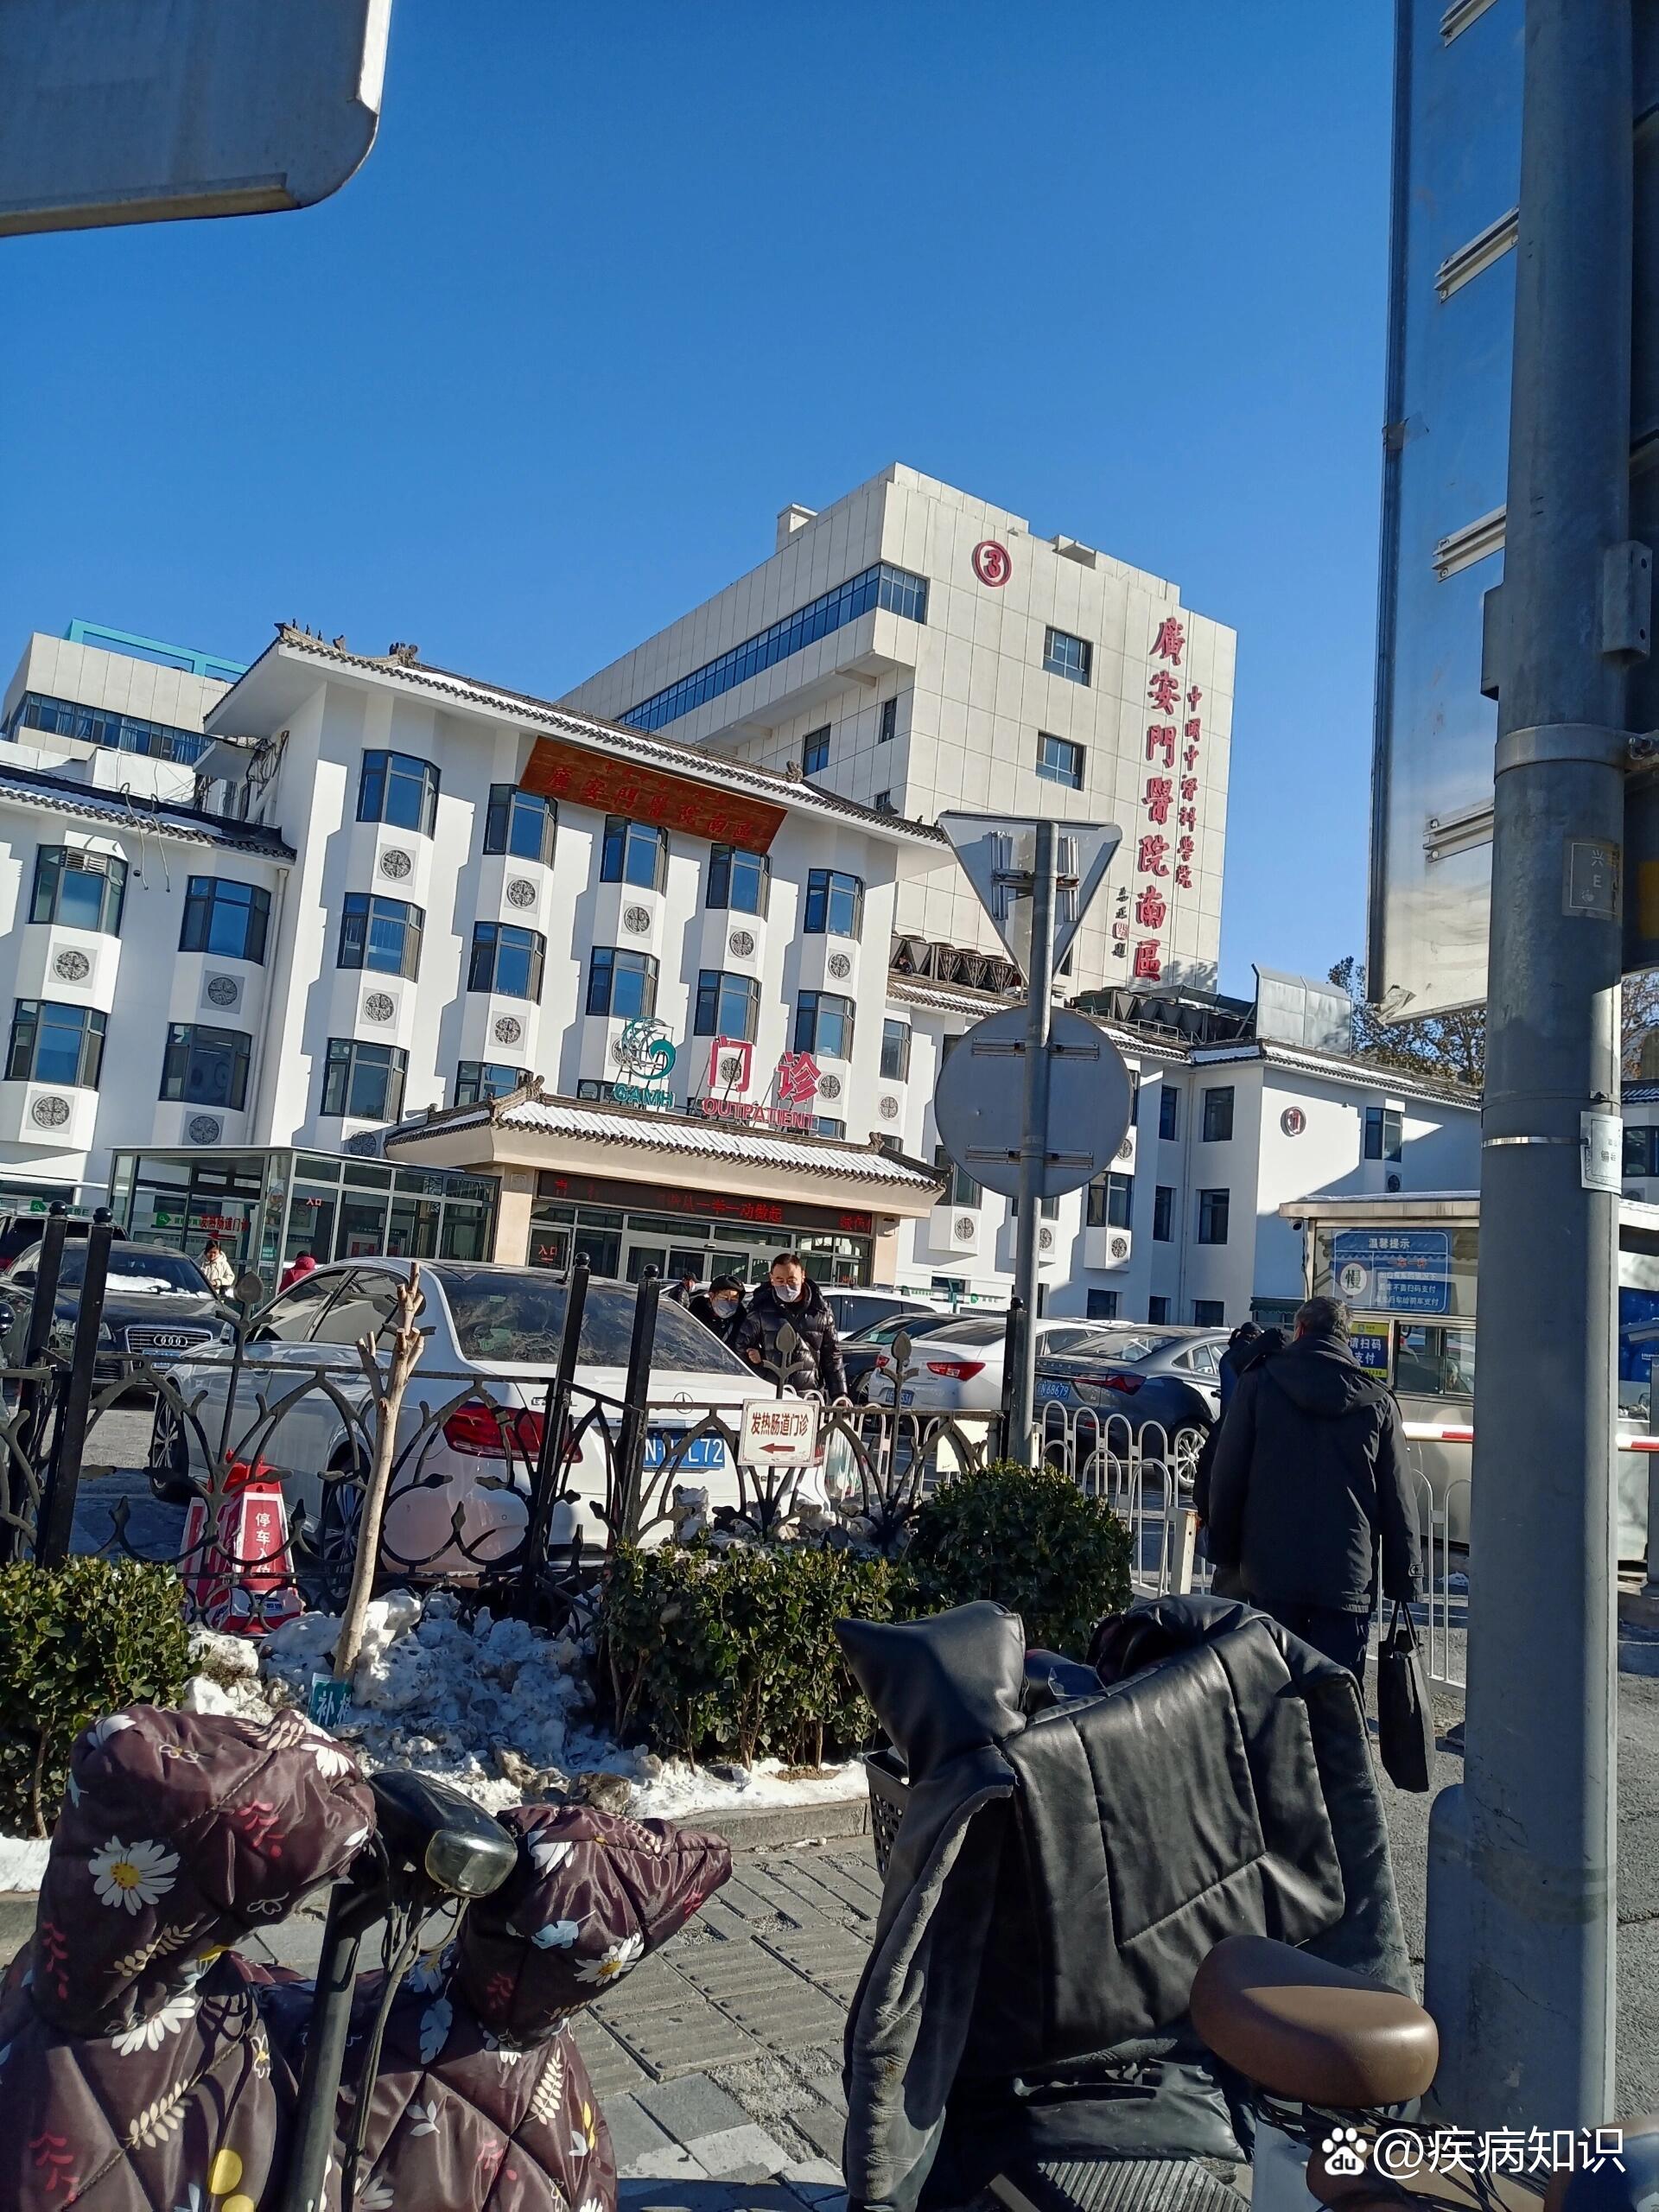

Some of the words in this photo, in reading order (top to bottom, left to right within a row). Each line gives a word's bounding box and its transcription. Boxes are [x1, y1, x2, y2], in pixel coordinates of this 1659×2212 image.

[1134, 617, 1185, 982] 廣安門醫院南區
[709, 1035, 821, 1104] 门诊
[613, 1083, 676, 1108] GAMH
[701, 1097, 819, 1130] OUTPATIENT
[306, 1197, 322, 1207] 入口
[200, 1216, 250, 1231] 发热肠道门诊
[538, 1244, 557, 1255] 入口
[1369, 1237, 1410, 1249] 温馨提示
[1345, 1269, 1361, 1289] 慢
[1350, 1337, 1381, 1351] 请扫码
[1355, 1351, 1376, 1364] 支付
[751, 1412, 809, 1437] 发热肠道门诊
